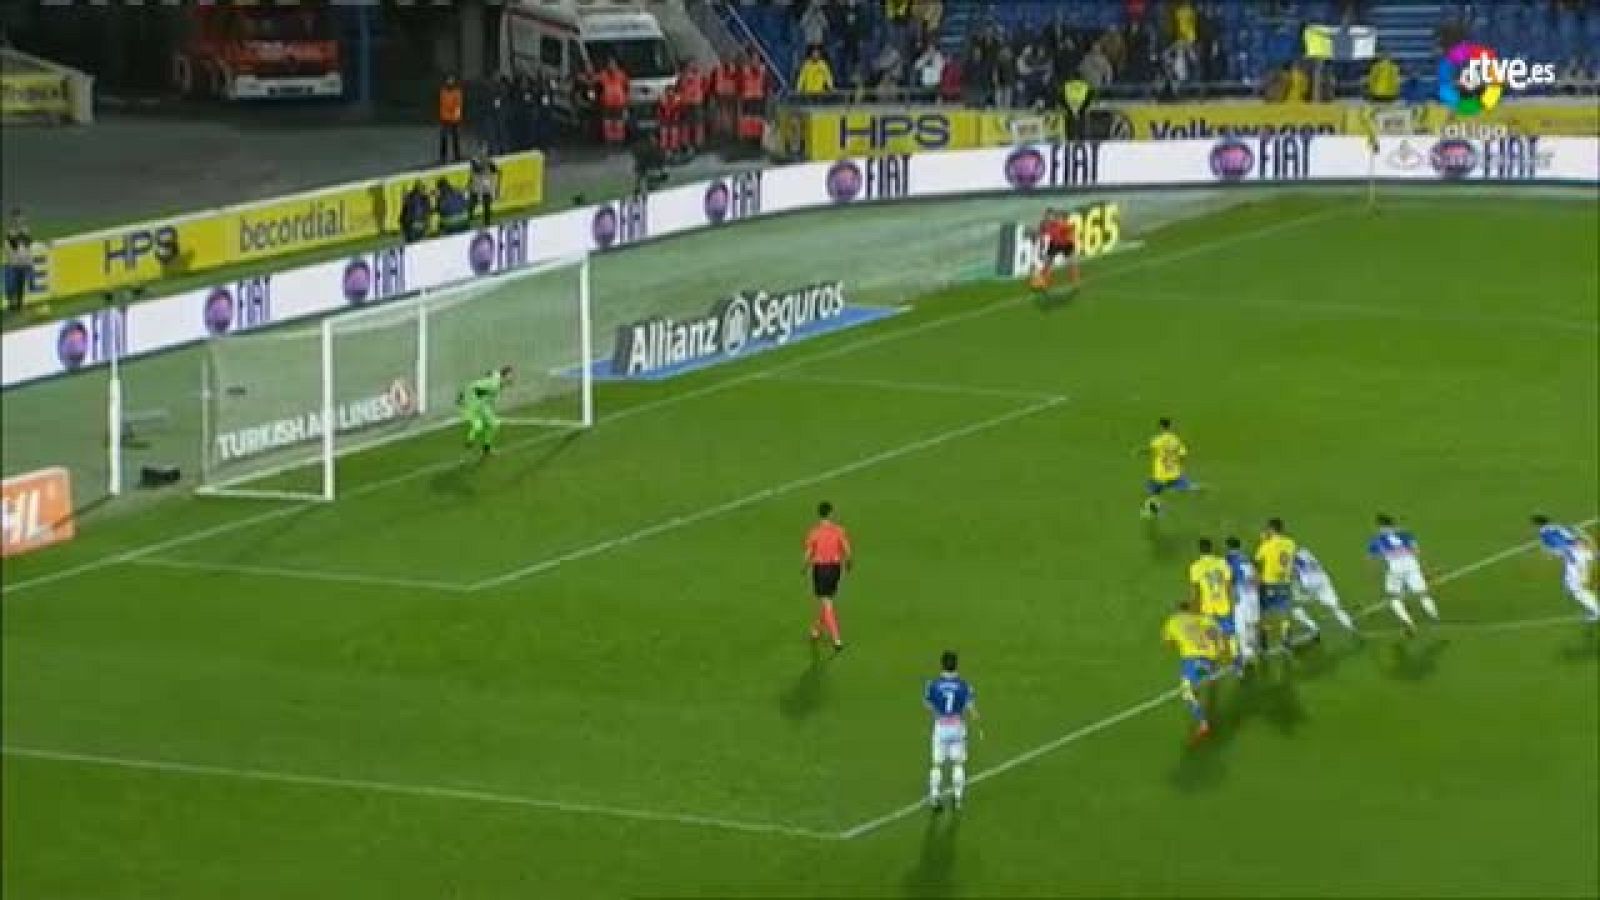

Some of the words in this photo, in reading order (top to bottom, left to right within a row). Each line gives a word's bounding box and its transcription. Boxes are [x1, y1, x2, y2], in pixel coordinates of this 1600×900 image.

[839, 114, 951, 149] HPS
[865, 153, 911, 198] FIAT
[1050, 142, 1100, 185] FIAT
[1259, 135, 1312, 180] FIAT
[732, 170, 762, 218] FIAT
[618, 192, 648, 248] FIAT
[103, 225, 180, 275] HPS
[499, 218, 528, 273] FIAT
[374, 244, 406, 299] FIAT
[237, 273, 271, 330] FIAT
[628, 316, 719, 376] Allianz
[751, 279, 844, 345] Seguros
[216, 410, 306, 461] TURKISH
